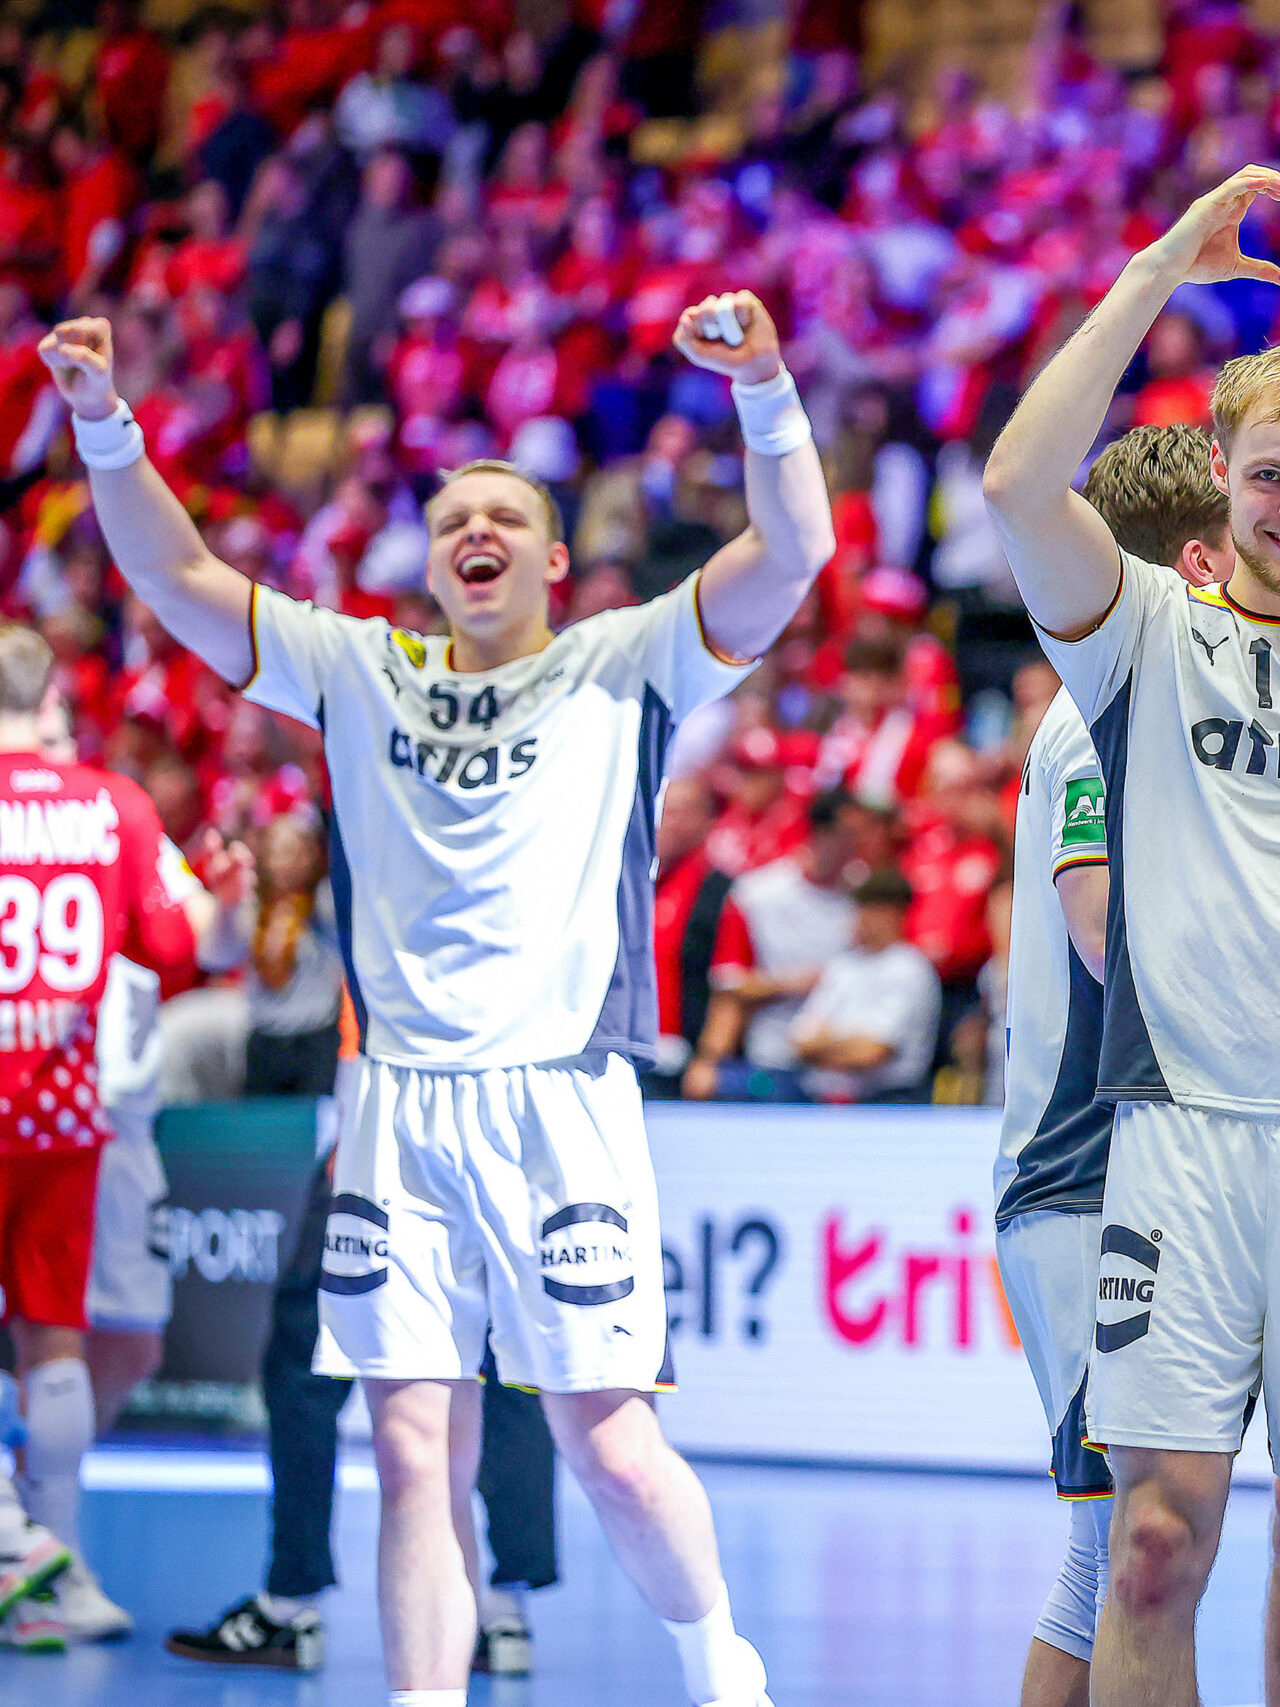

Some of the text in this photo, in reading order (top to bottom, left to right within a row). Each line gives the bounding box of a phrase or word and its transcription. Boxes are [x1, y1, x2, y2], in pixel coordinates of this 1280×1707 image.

[429, 680, 499, 731] 54
[389, 727, 538, 789] atlas
[0, 873, 105, 993] 39
[158, 1207, 286, 1282] PORT
[1099, 1277, 1154, 1302] RTING
